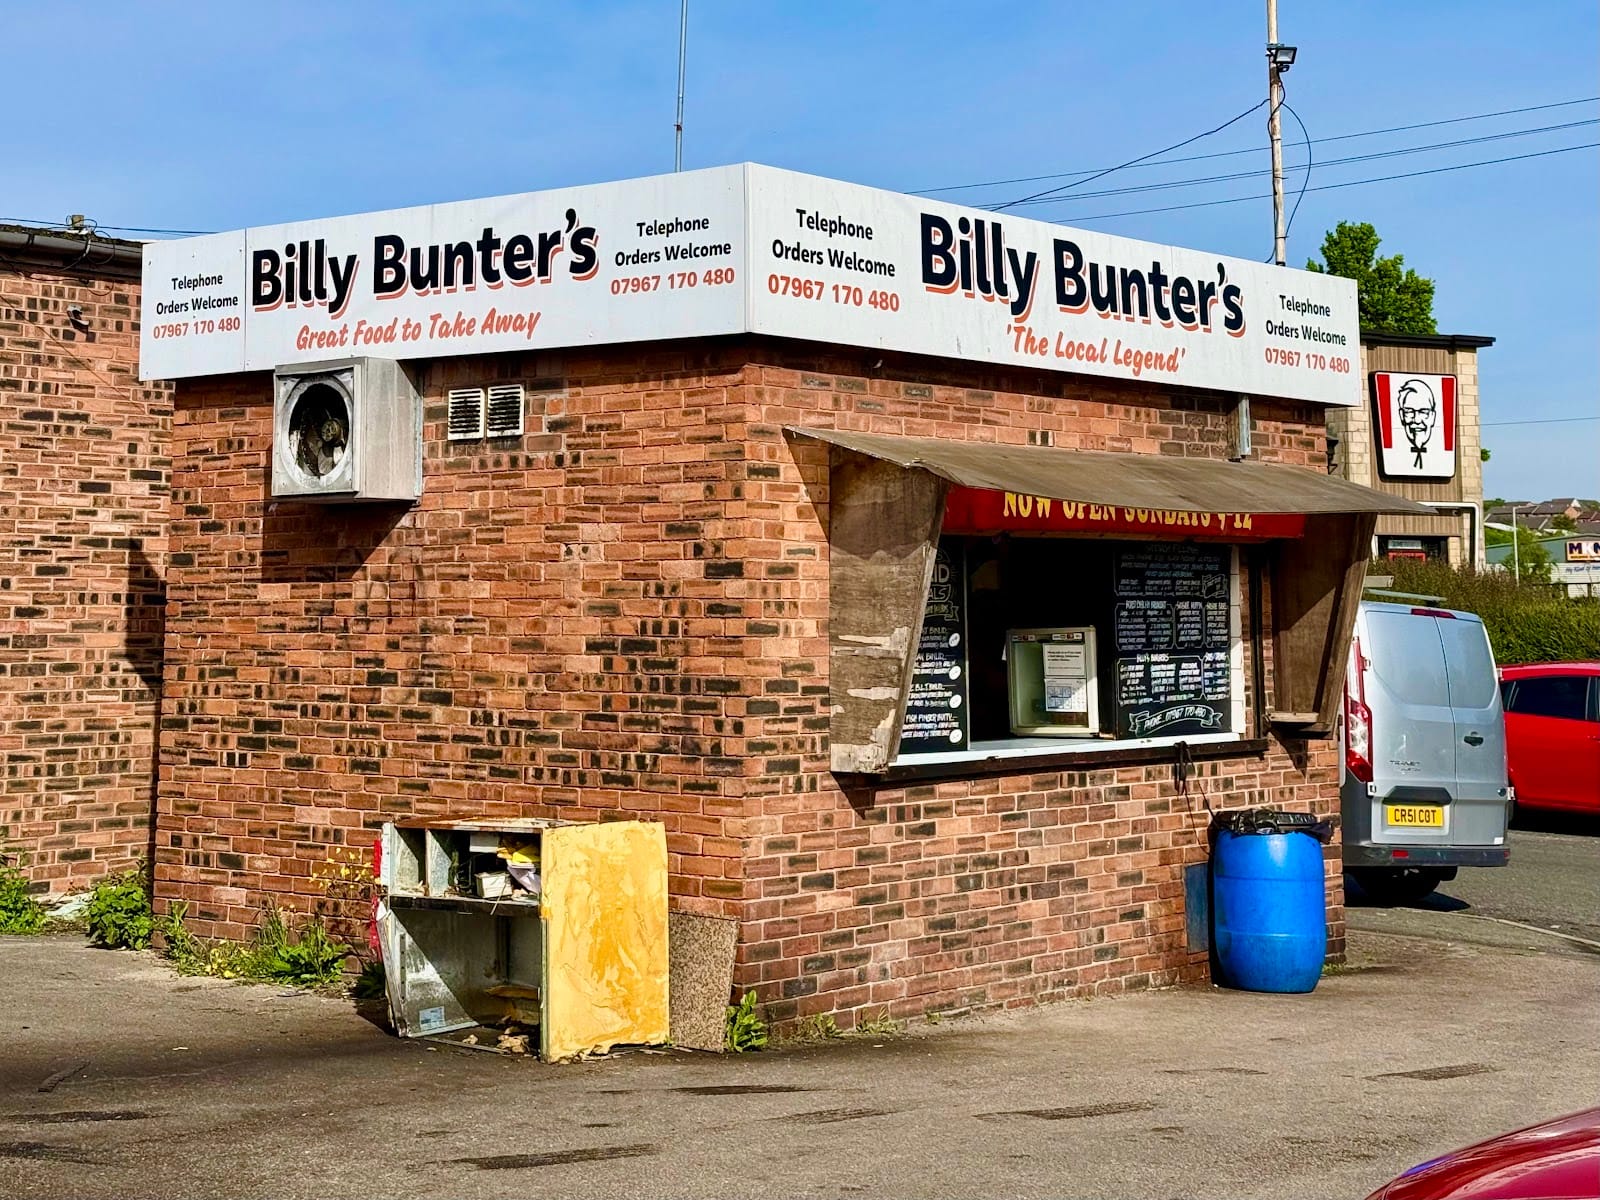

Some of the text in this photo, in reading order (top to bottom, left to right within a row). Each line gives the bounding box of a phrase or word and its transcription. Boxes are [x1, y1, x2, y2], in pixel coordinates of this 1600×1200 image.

[637, 217, 709, 238] Telephone
[796, 209, 872, 240] Telephone
[252, 208, 599, 320] Billy Bunter's
[615, 243, 731, 266] Orders Welcome
[773, 239, 895, 277] Orders Welcome
[172, 274, 222, 291] Telephone
[611, 268, 734, 294] 07967 170 480
[921, 212, 1246, 338] Billy Bunter's
[157, 296, 238, 315] Orders Welcome
[768, 274, 899, 311] 07967 170 480
[1280, 295, 1330, 316] Telephone
[154, 317, 240, 338] 07967 170 480
[297, 308, 541, 350] Great Food to Take Away
[1266, 320, 1346, 345] Orders Welcome
[1008, 325, 1185, 376] 'The Local Legend'
[1266, 348, 1349, 373] 07967 170 480
[1003, 492, 1052, 518] NOW
[1062, 501, 1117, 521] OPEN
[1124, 507, 1211, 527] SUNDAYS
